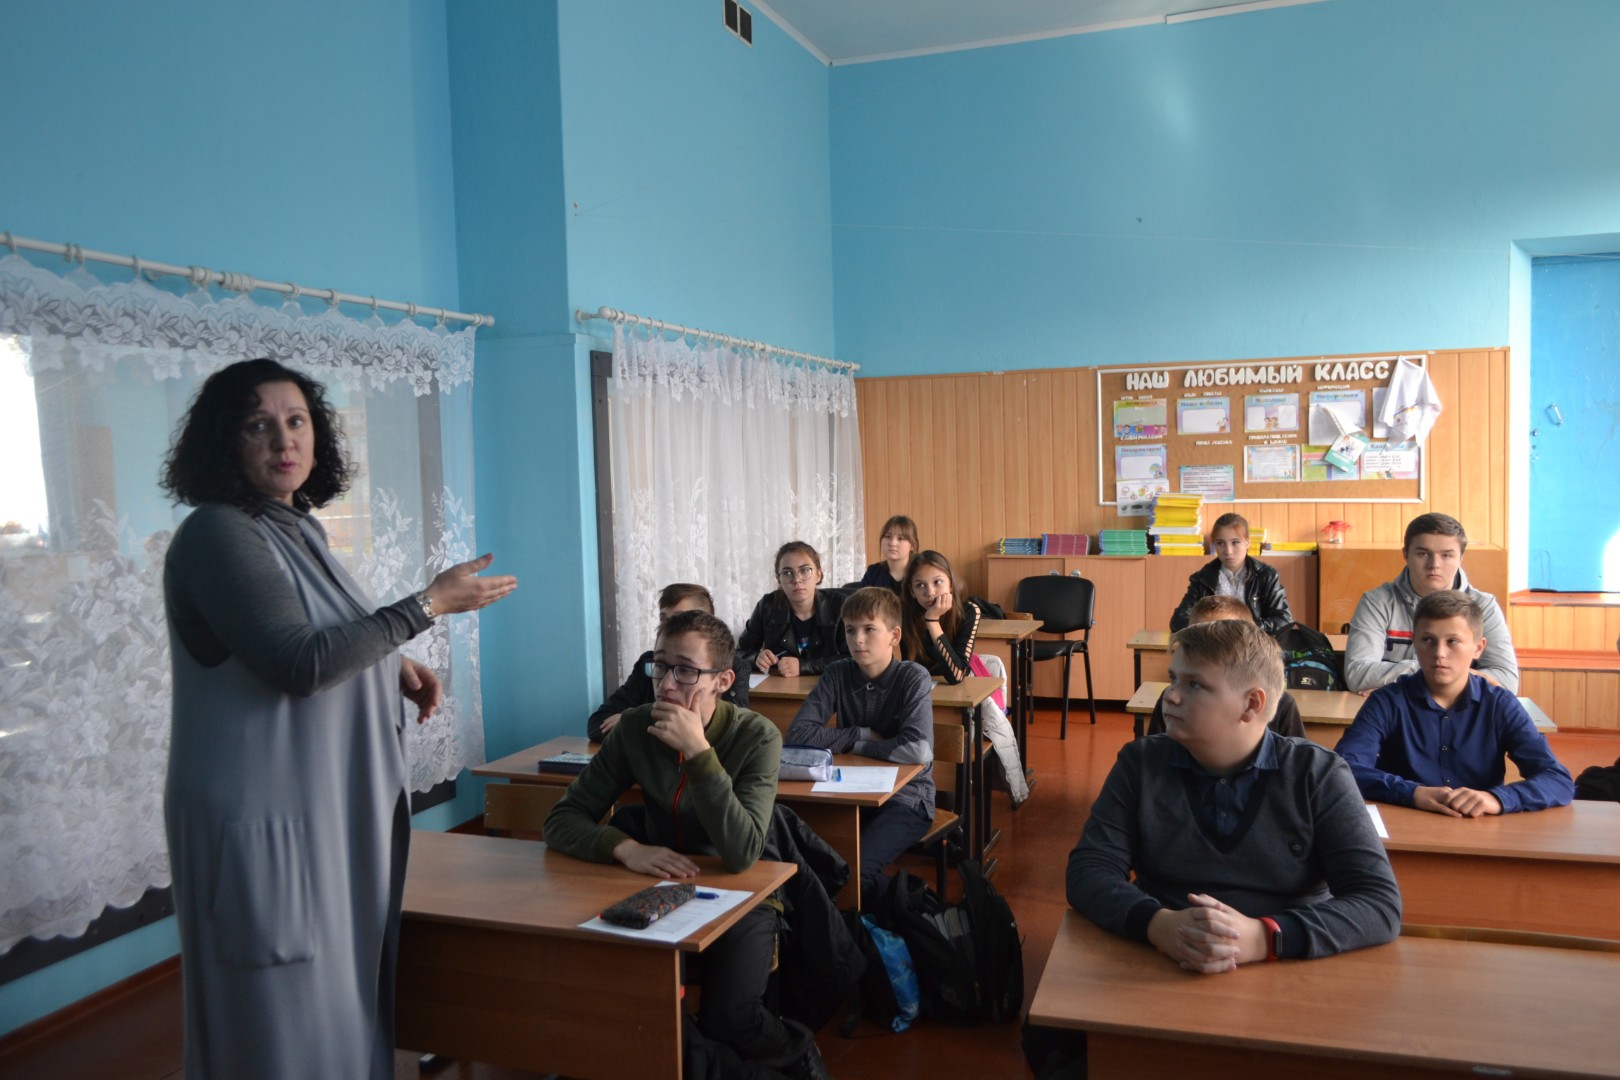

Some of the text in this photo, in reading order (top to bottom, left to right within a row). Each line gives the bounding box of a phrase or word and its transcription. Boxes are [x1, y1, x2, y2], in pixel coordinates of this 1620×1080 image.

[1126, 361, 1390, 390] НАШ ЛЮБИМЫЙ КЛАСС
